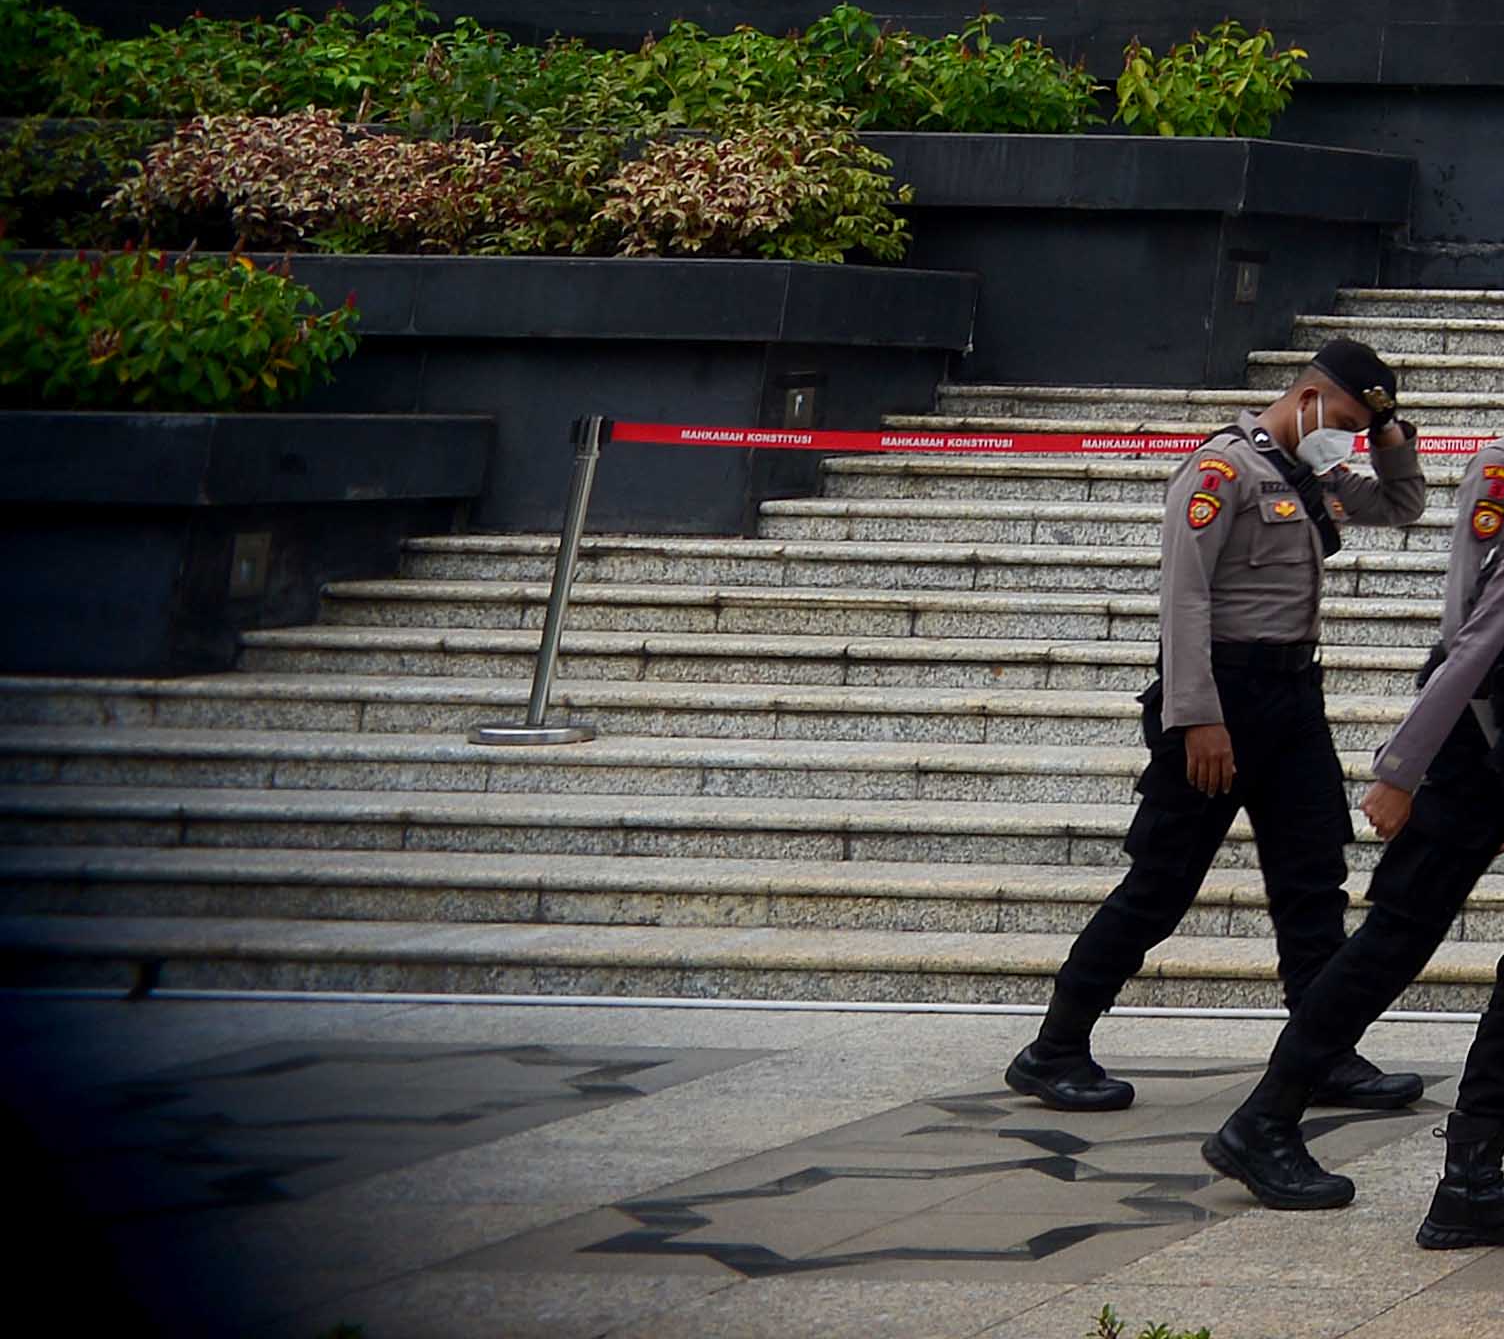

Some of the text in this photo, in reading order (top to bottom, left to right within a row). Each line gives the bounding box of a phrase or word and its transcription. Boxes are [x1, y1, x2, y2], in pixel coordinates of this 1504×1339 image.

[681, 430, 812, 444] MAHKAMAH KONSTITUSI
[881, 436, 1013, 448] MAHKAMAH KONSTITUSI
[1082, 439, 1203, 449] MAHKAMAH KONSTIT
[1420, 438, 1476, 450] KONSTITUSI
